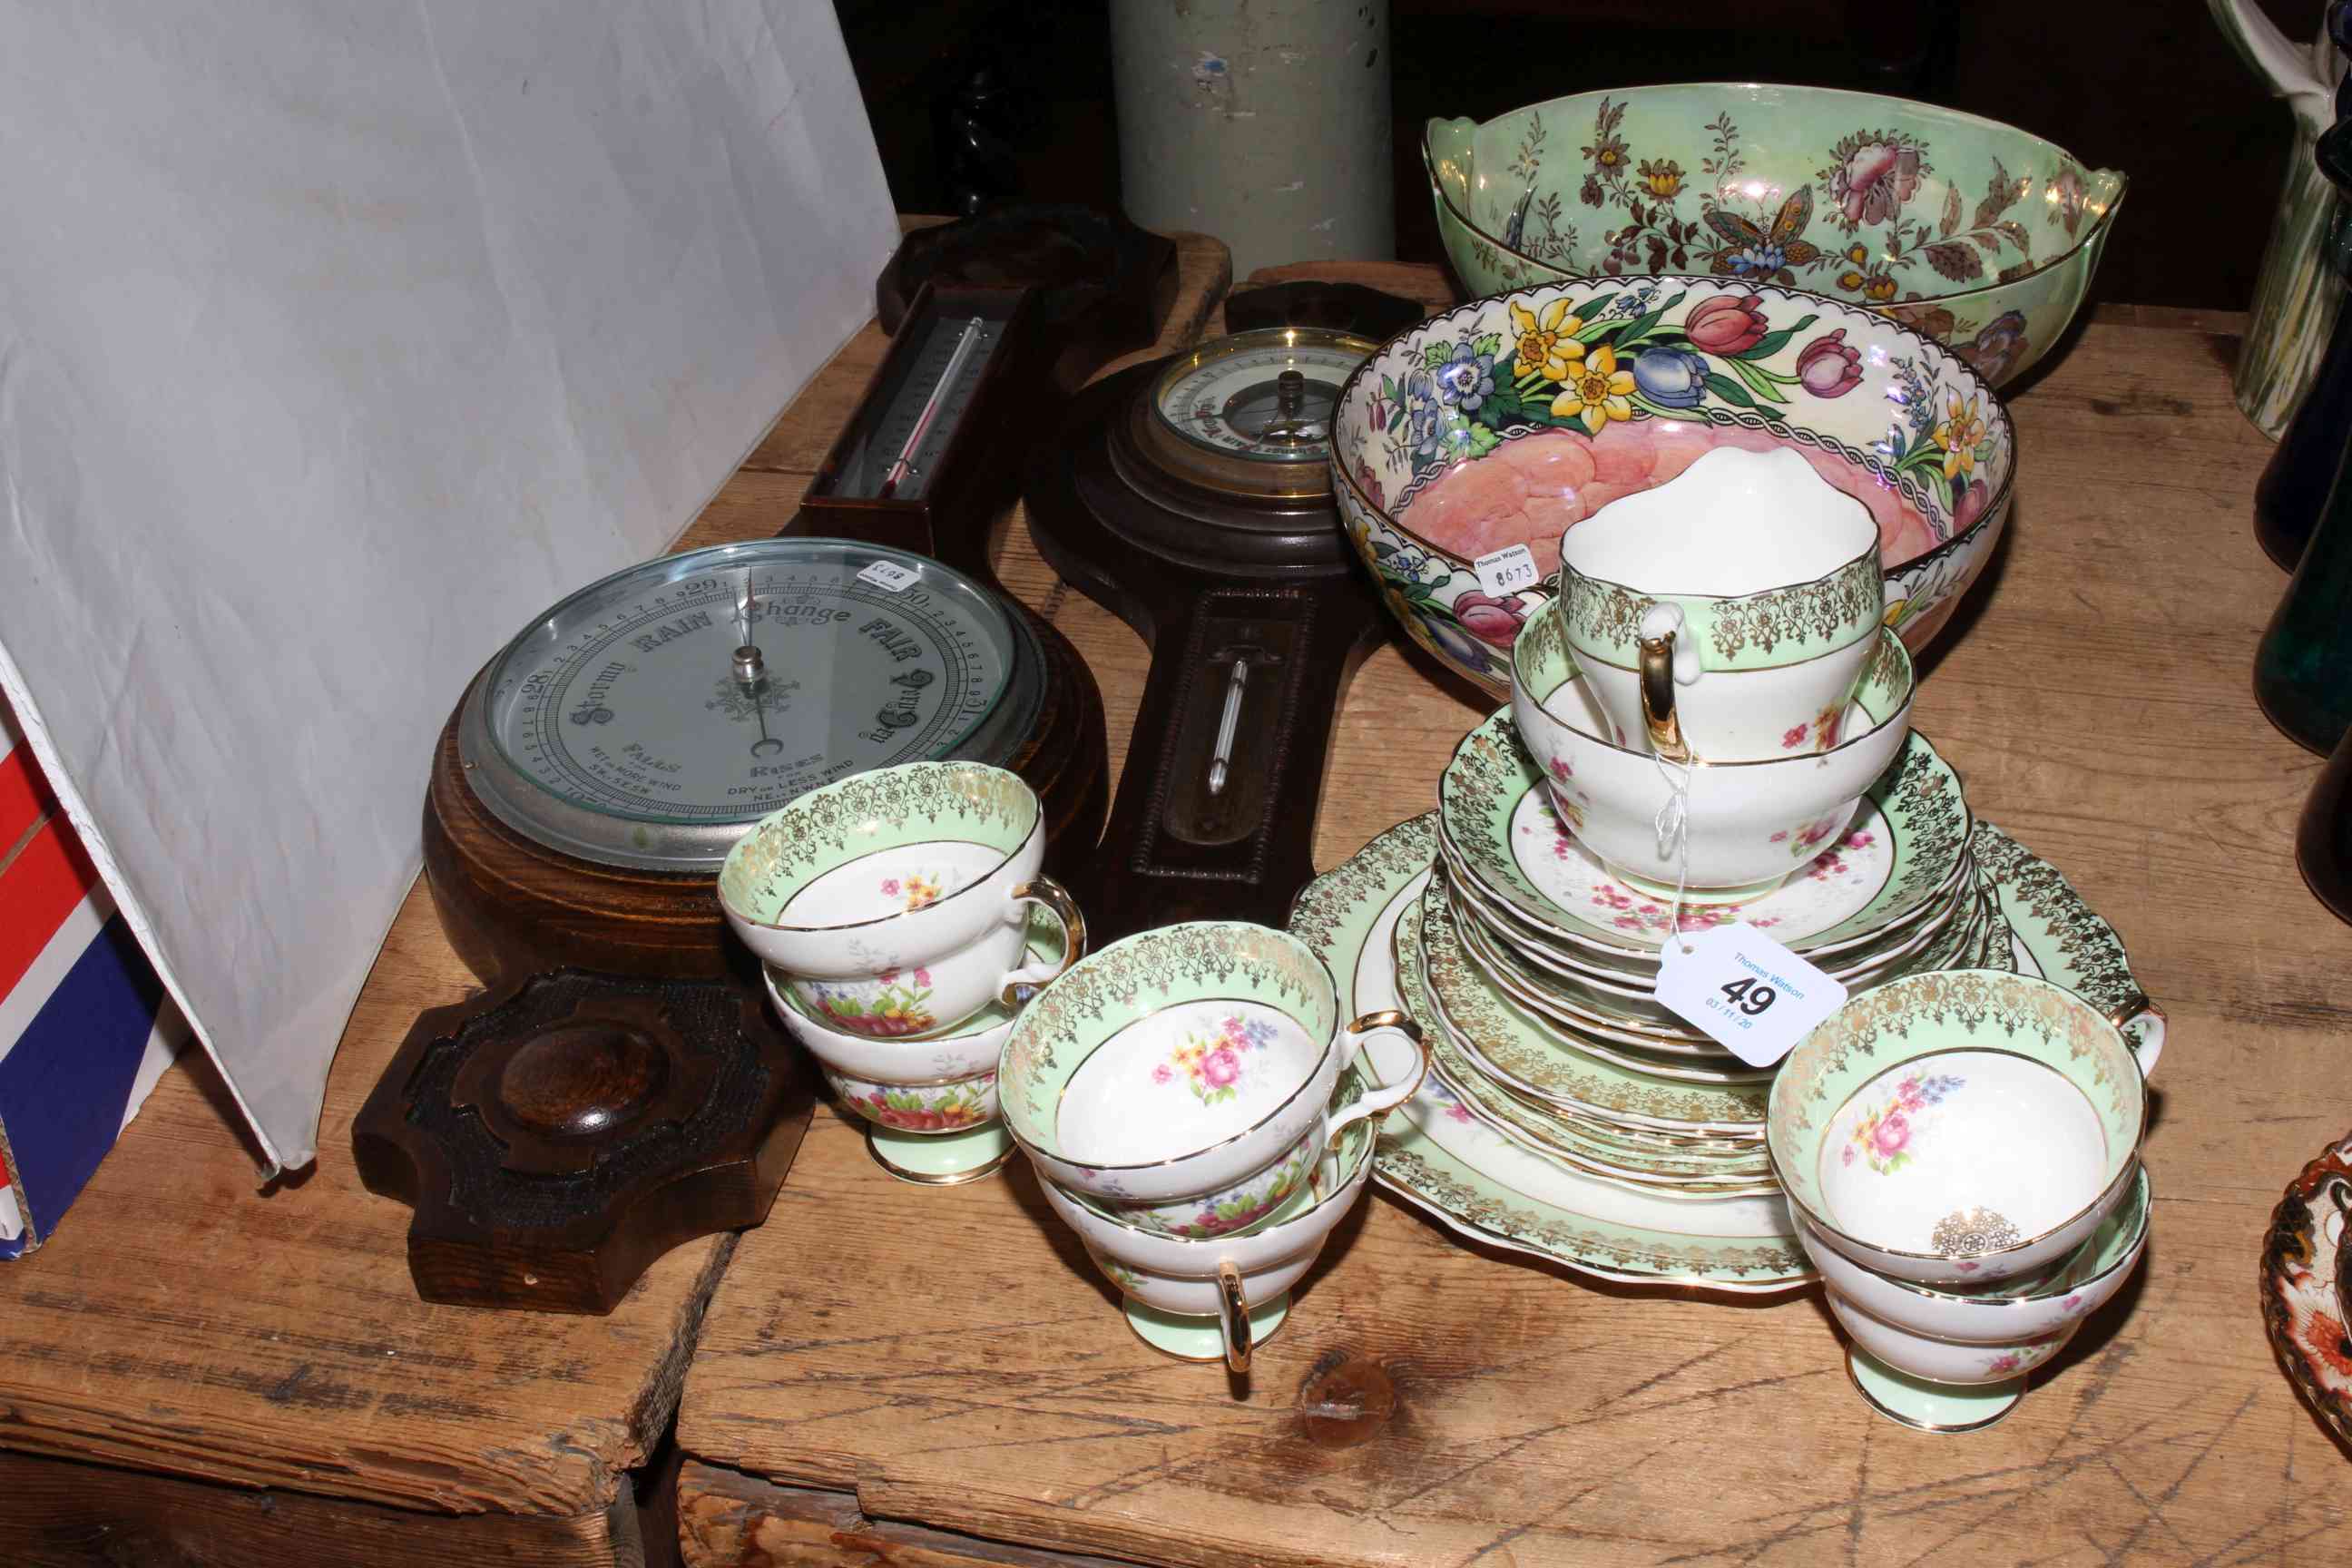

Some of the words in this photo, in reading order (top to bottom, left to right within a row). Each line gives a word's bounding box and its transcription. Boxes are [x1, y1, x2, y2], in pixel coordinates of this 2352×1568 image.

[684, 579, 717, 595] 29
[633, 609, 713, 653] RAIN
[858, 617, 923, 662] FAIR
[727, 786, 757, 796] DRY
[779, 773, 817, 789] LESS
[822, 759, 855, 778] WIND
[1720, 977, 1777, 1015] 49
[1734, 951, 1769, 979] Thomas
[1769, 972, 1806, 1002] Watson
